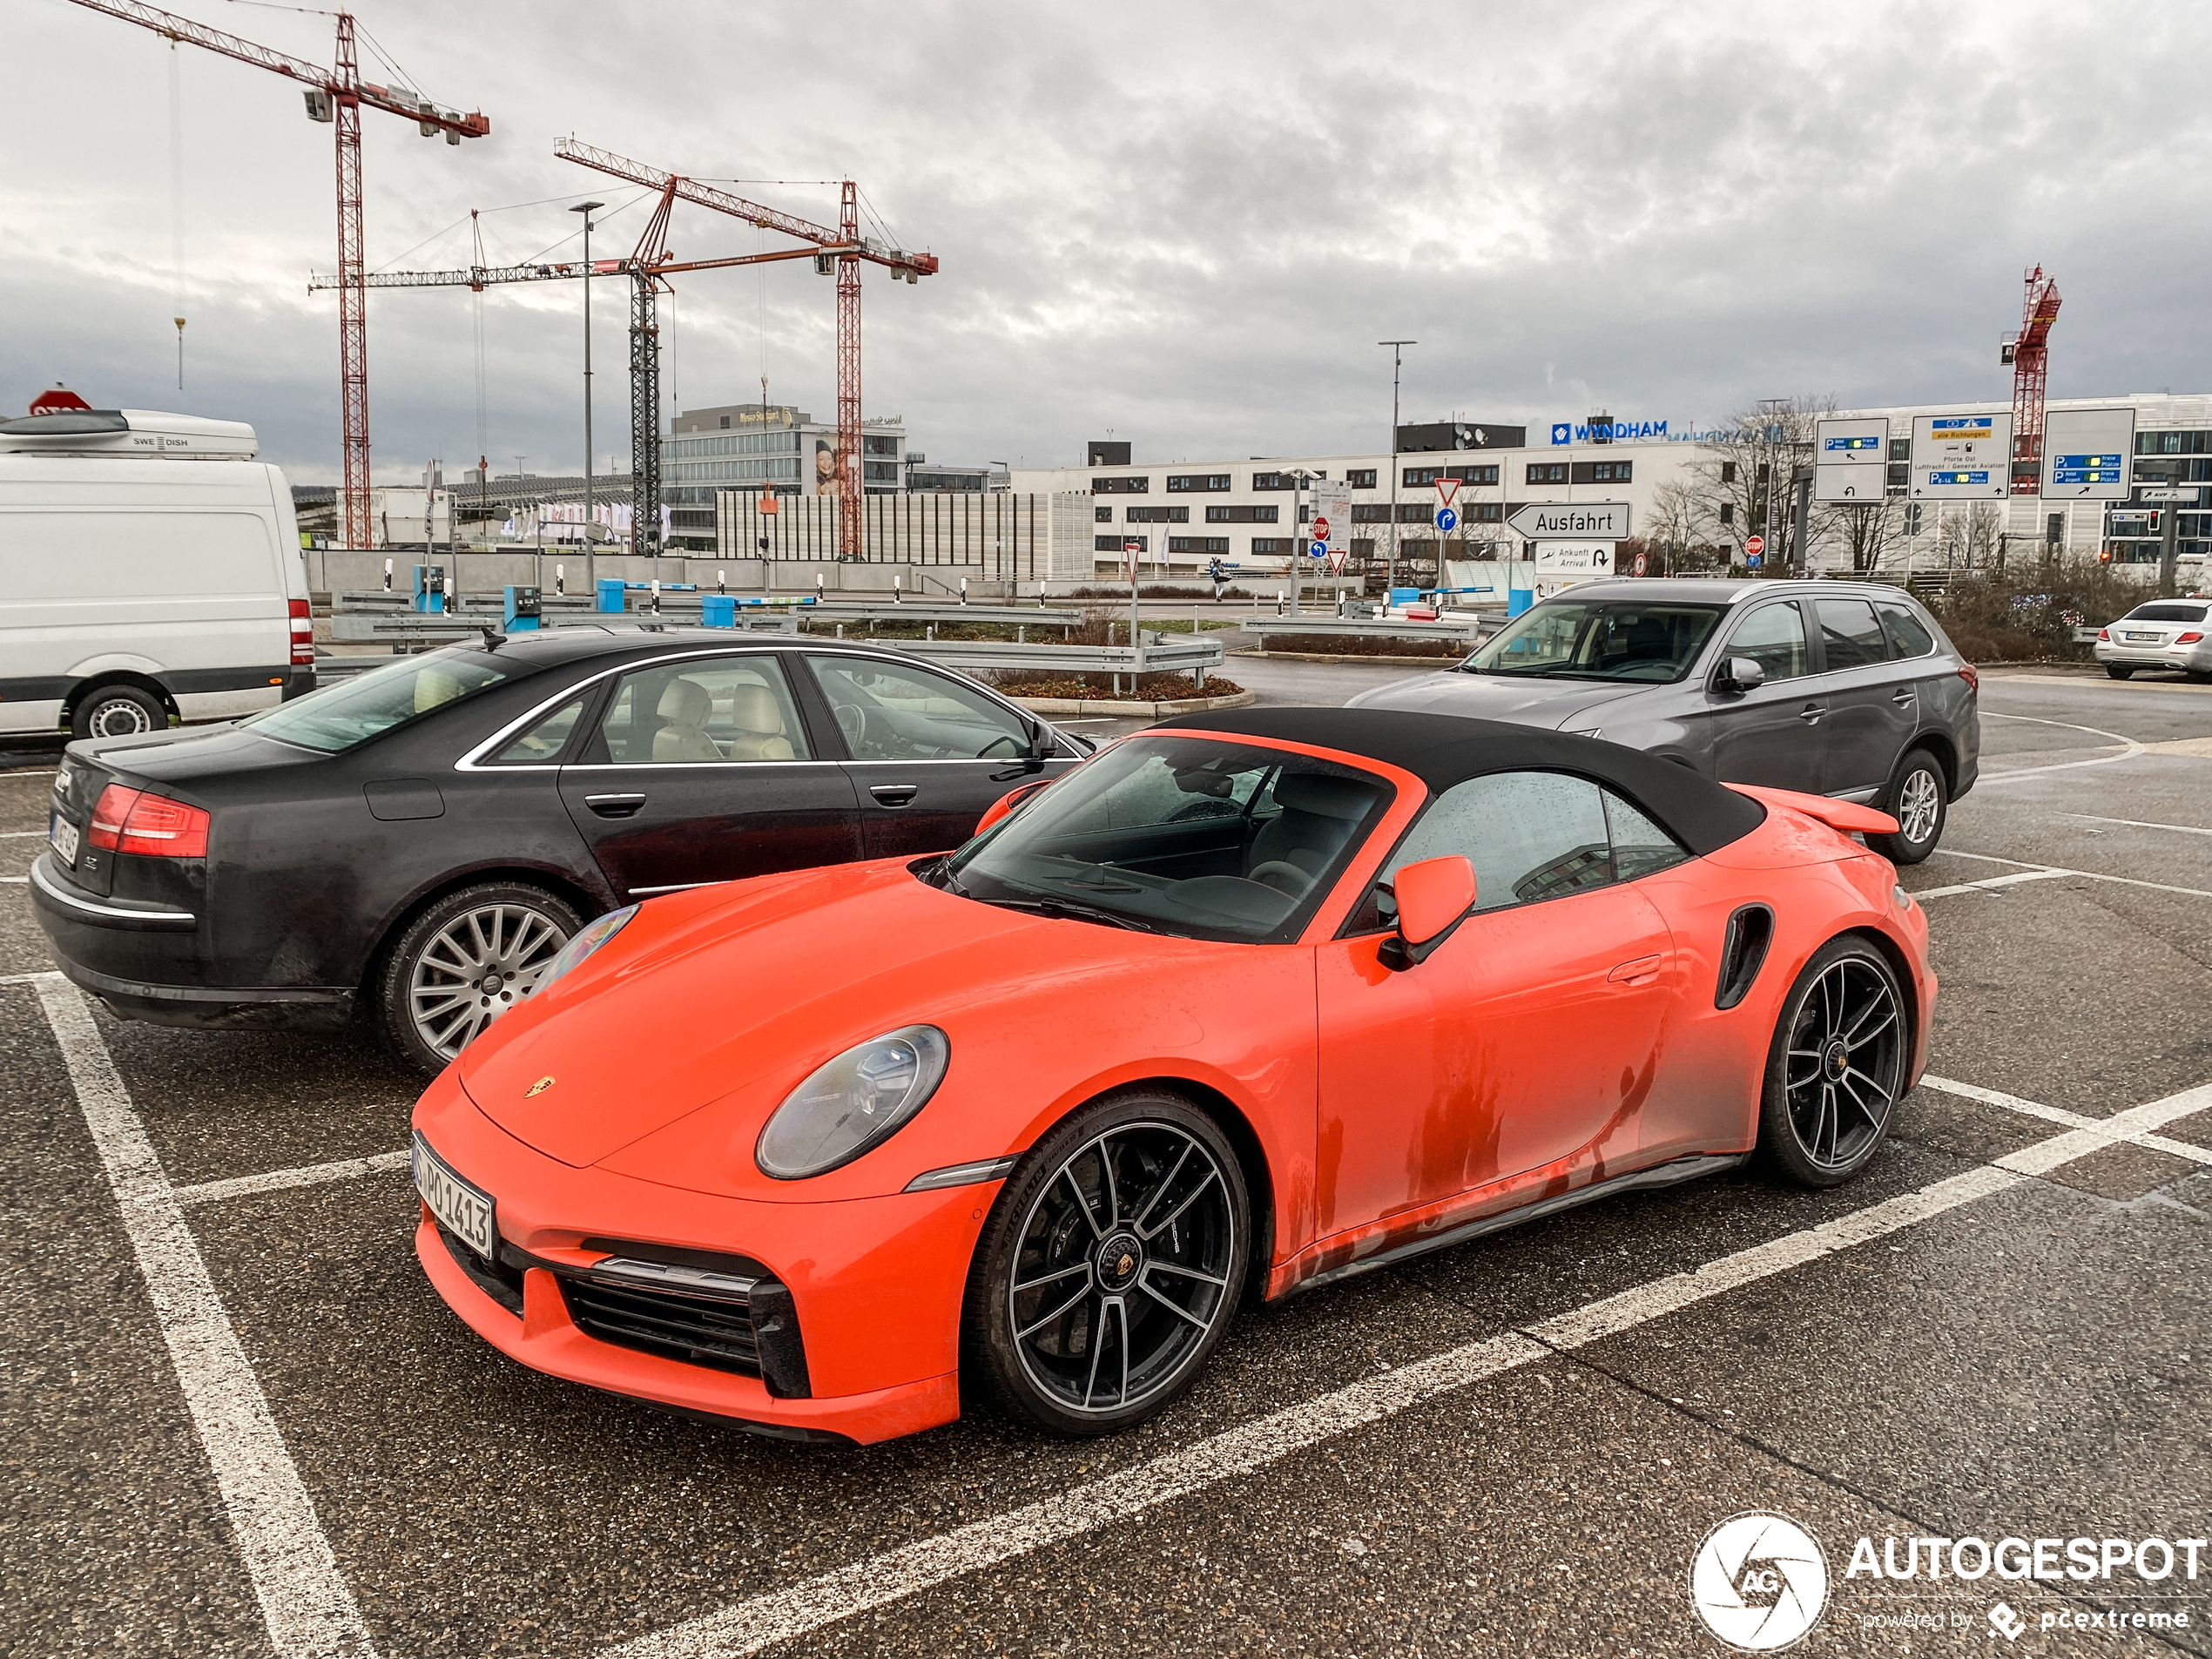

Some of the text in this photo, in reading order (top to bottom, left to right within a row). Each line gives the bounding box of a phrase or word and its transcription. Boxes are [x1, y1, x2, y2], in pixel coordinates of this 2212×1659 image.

[1575, 421, 1667, 440] WYNDHAM
[1825, 439, 1834, 449] P
[2054, 471, 2064, 482] P
[1535, 512, 1612, 530] Ausfahrt
[1314, 523, 1328, 534] STOP
[1559, 548, 1589, 556] Ankunft
[416, 1149, 422, 1188] S
[445, 1183, 487, 1247] 1413
[1003, 1168, 1044, 1244] MICHELIN
